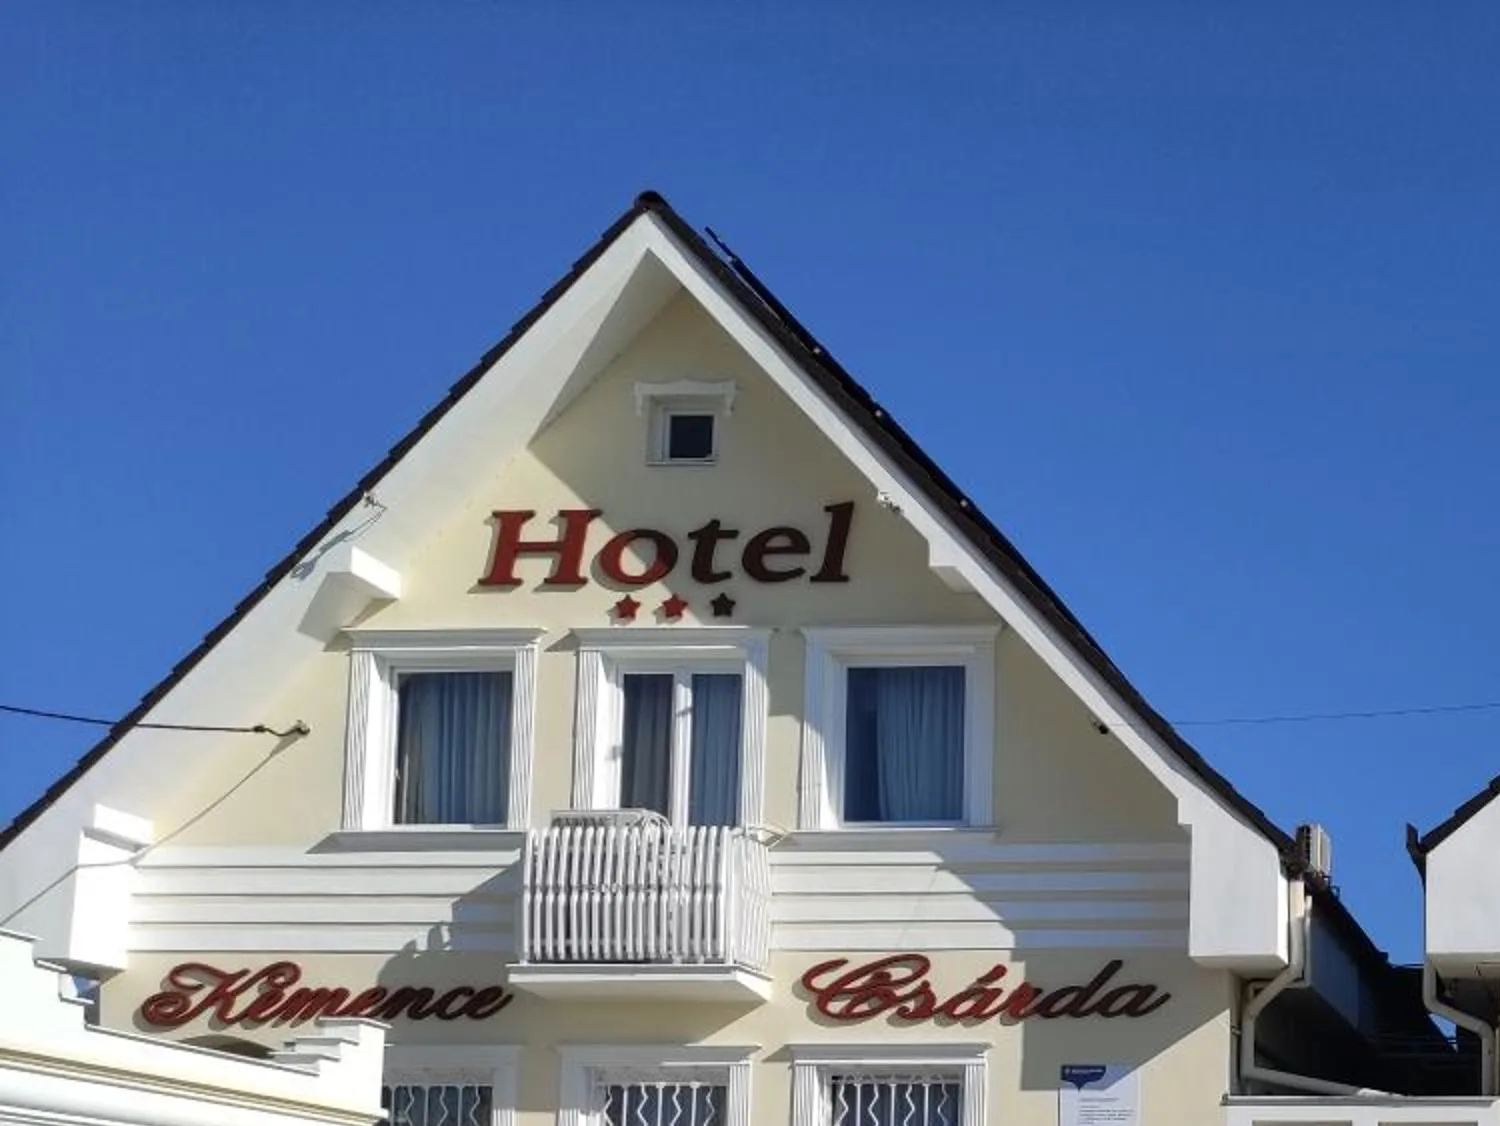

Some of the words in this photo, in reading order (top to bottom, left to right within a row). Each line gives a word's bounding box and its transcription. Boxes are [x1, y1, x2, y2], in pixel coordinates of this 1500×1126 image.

[477, 500, 855, 586] Hotel
[141, 960, 514, 1028] Kemence
[801, 953, 1171, 1020] Csárda
